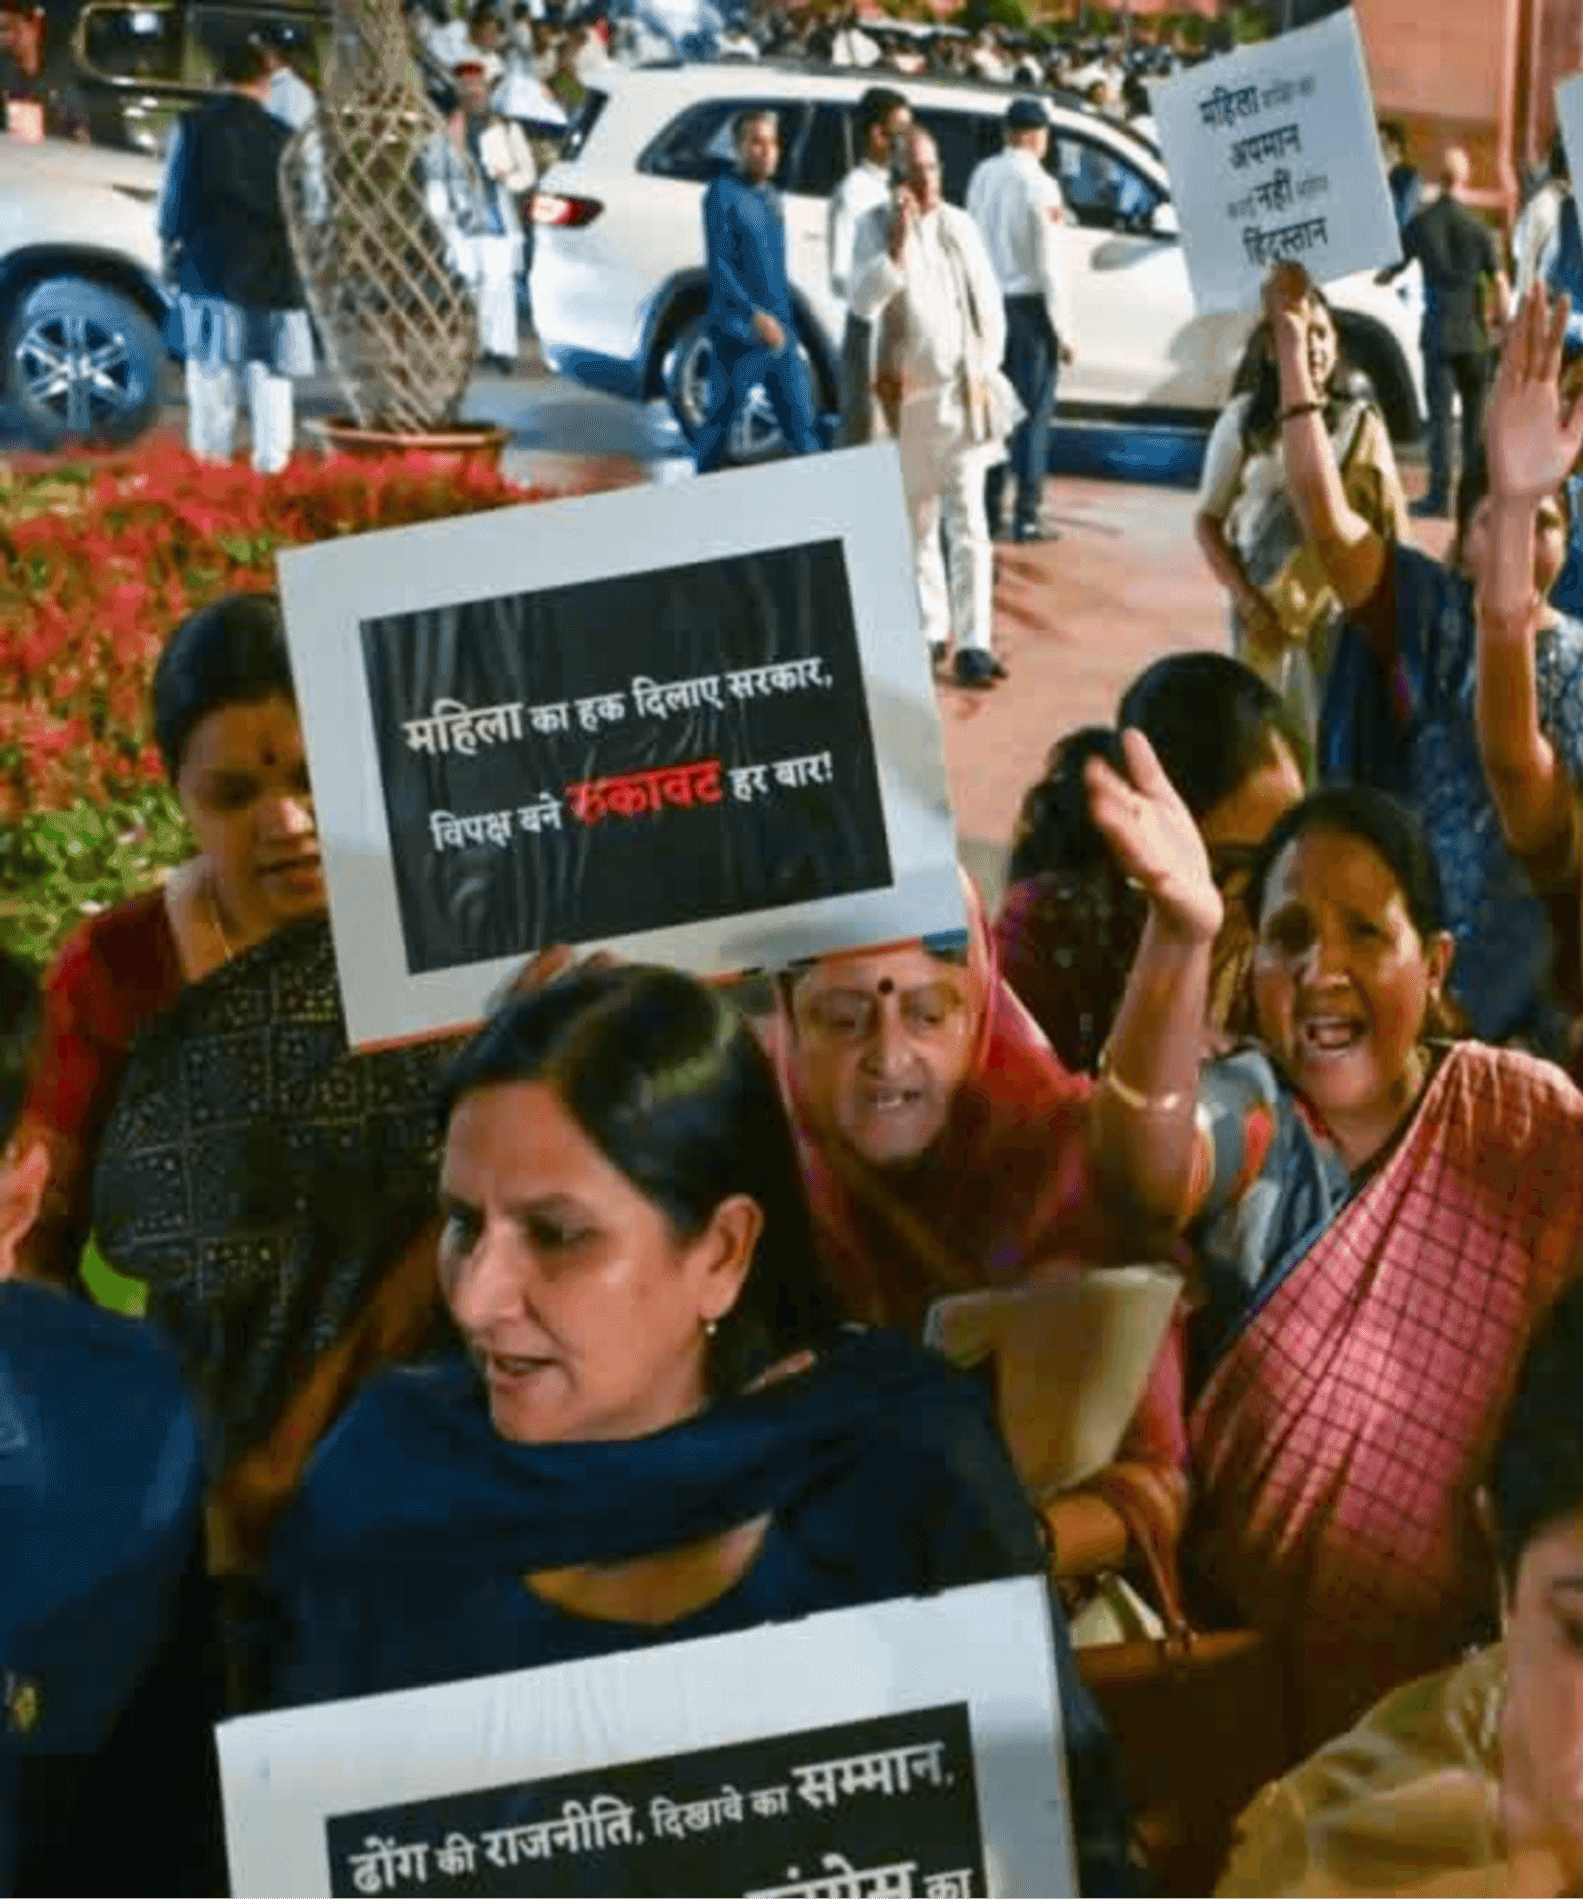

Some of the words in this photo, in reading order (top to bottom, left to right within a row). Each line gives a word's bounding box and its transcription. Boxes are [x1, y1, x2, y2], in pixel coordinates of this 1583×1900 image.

[402, 697, 526, 757] महिला
[527, 701, 570, 735] का
[573, 692, 628, 732] हक
[631, 675, 724, 721] दिलाए
[724, 656, 834, 700] सरकार,
[430, 809, 513, 852] विपक्ष
[516, 791, 563, 833] बने
[727, 764, 770, 802] हर
[771, 750, 833, 788] बार!
[348, 1833, 430, 1895] ढोंग
[434, 1832, 477, 1875] की
[480, 1795, 646, 1869] राजनीति,
[650, 1784, 744, 1839] दिखावे
[749, 1785, 790, 1817] का
